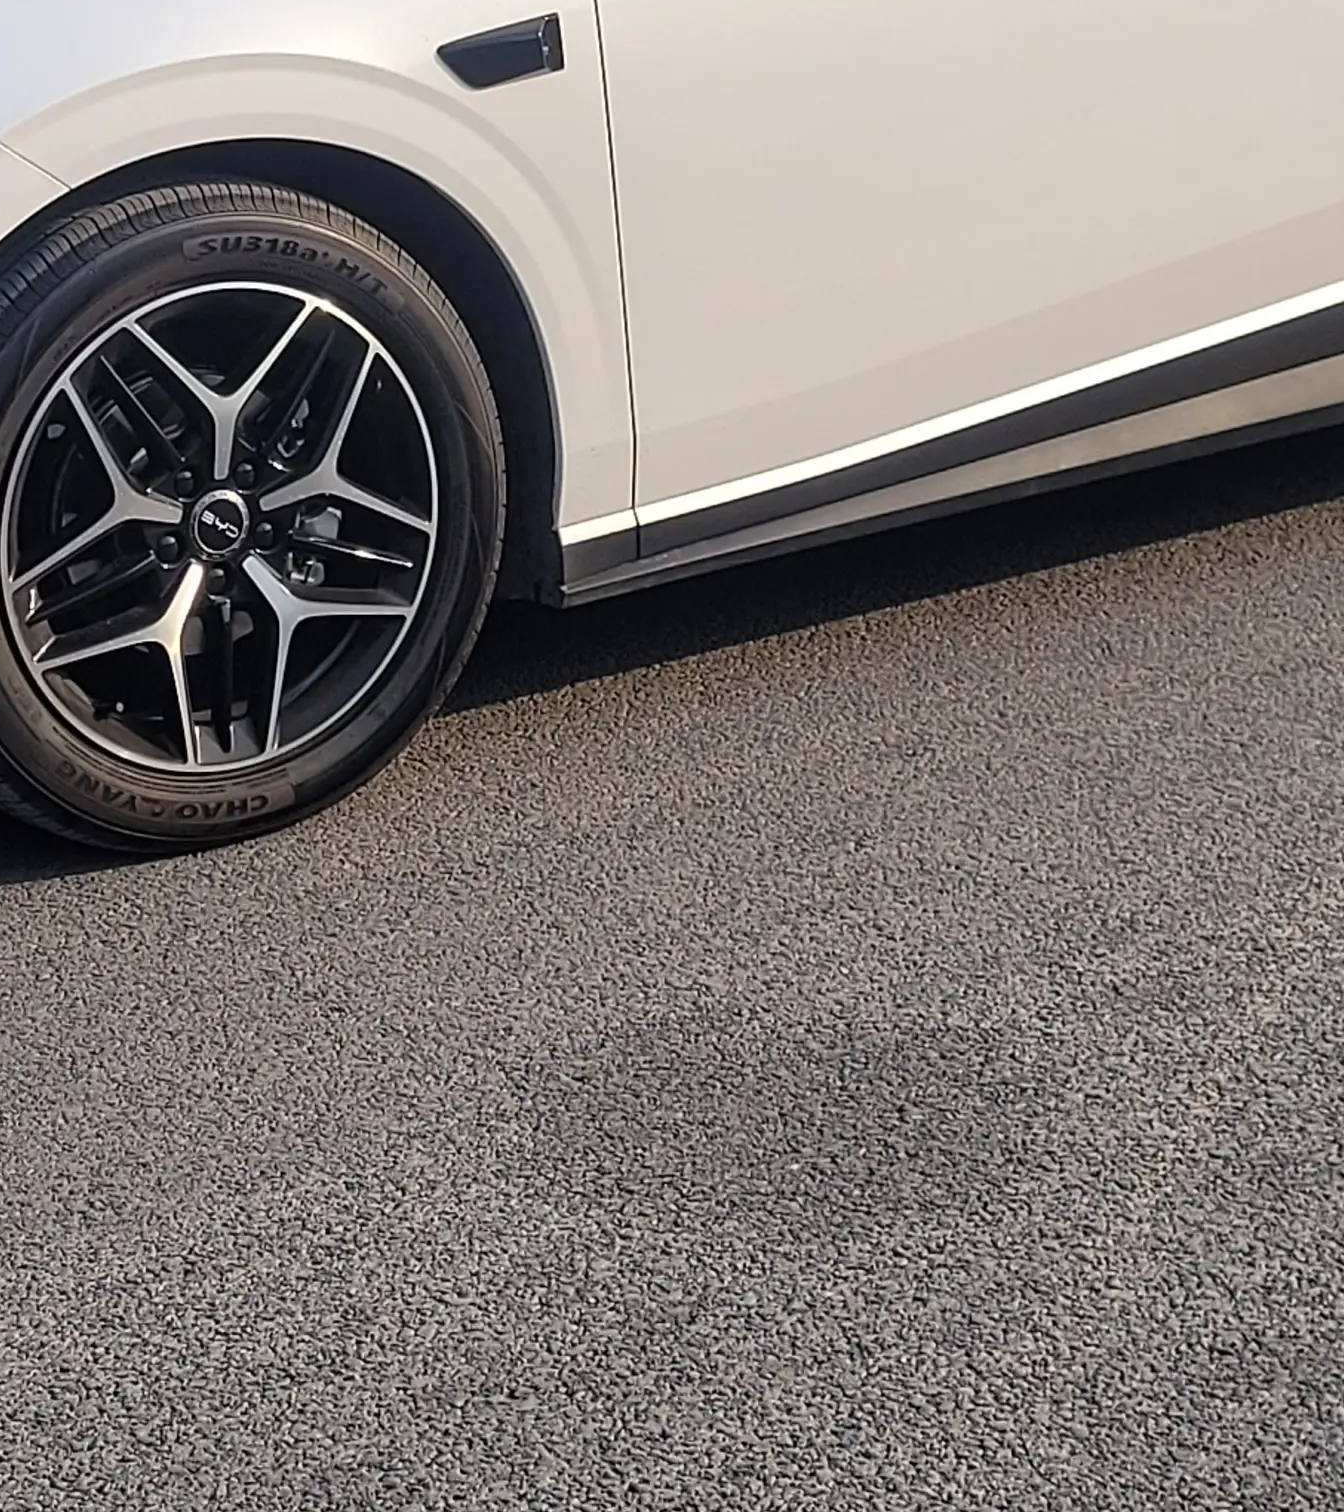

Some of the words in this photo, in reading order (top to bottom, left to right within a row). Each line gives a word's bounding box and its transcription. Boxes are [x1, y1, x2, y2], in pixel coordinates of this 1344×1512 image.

[334, 257, 389, 294] H/T
[201, 510, 239, 538] BYD
[56, 759, 143, 813] YANG
[174, 794, 269, 819] CHAO
